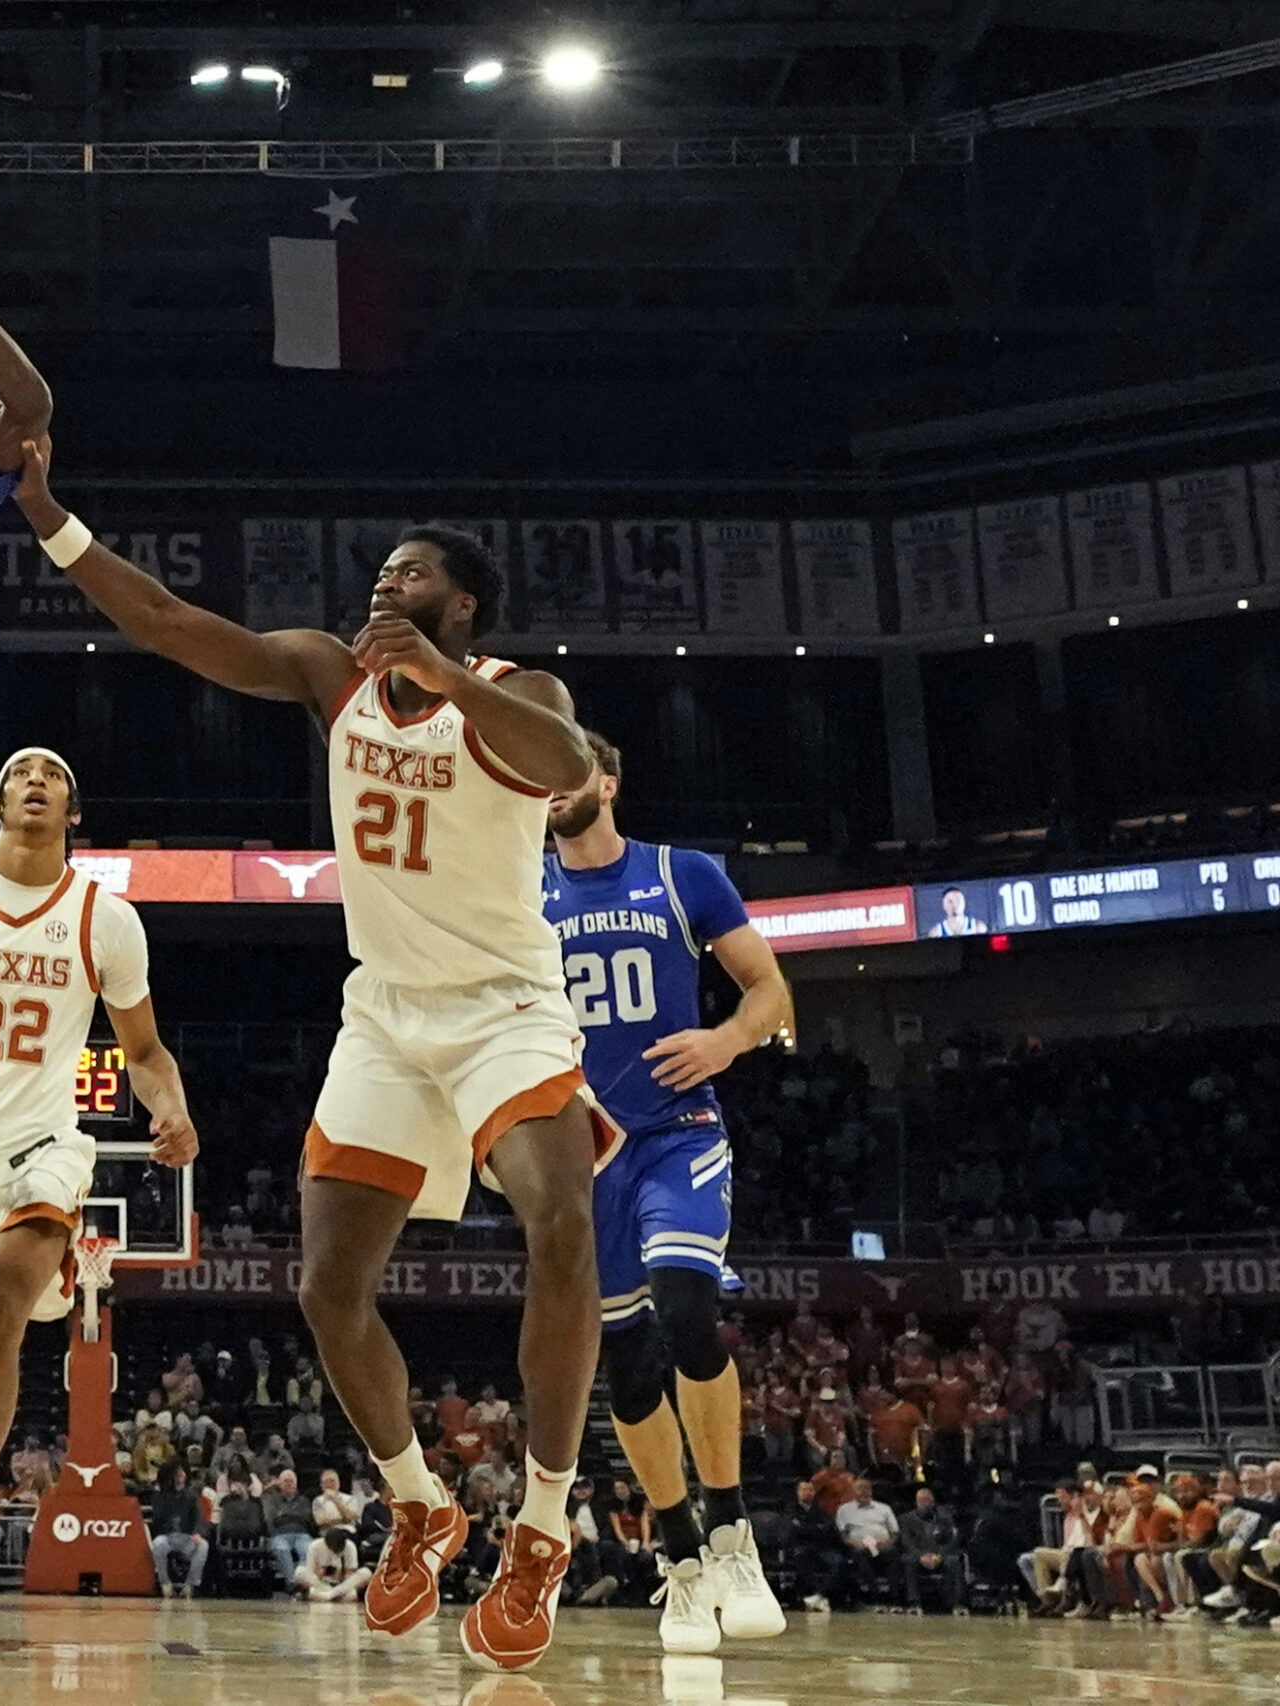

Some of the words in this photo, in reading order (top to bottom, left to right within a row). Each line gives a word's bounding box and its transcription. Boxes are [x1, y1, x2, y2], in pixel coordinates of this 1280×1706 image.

[344, 731, 457, 792] TEXAS
[352, 787, 433, 876] 21
[1050, 874, 1077, 898] DAE
[1078, 872, 1104, 895] DAE
[1105, 867, 1159, 893] HUNTER
[1199, 861, 1228, 884] PTS
[999, 881, 1036, 926] 10
[1053, 899, 1100, 923] GUARD
[45, 921, 68, 943] SEC
[552, 915, 579, 942] EW
[582, 910, 668, 940] ORLEANS
[564, 947, 657, 1027] 20
[75, 1072, 117, 1112] 22
[161, 1259, 272, 1293] HOME
[376, 1261, 427, 1295] HE
[442, 1262, 530, 1297] TEX
[960, 1264, 1080, 1302] HOOK
[83, 1519, 132, 1538] razr
